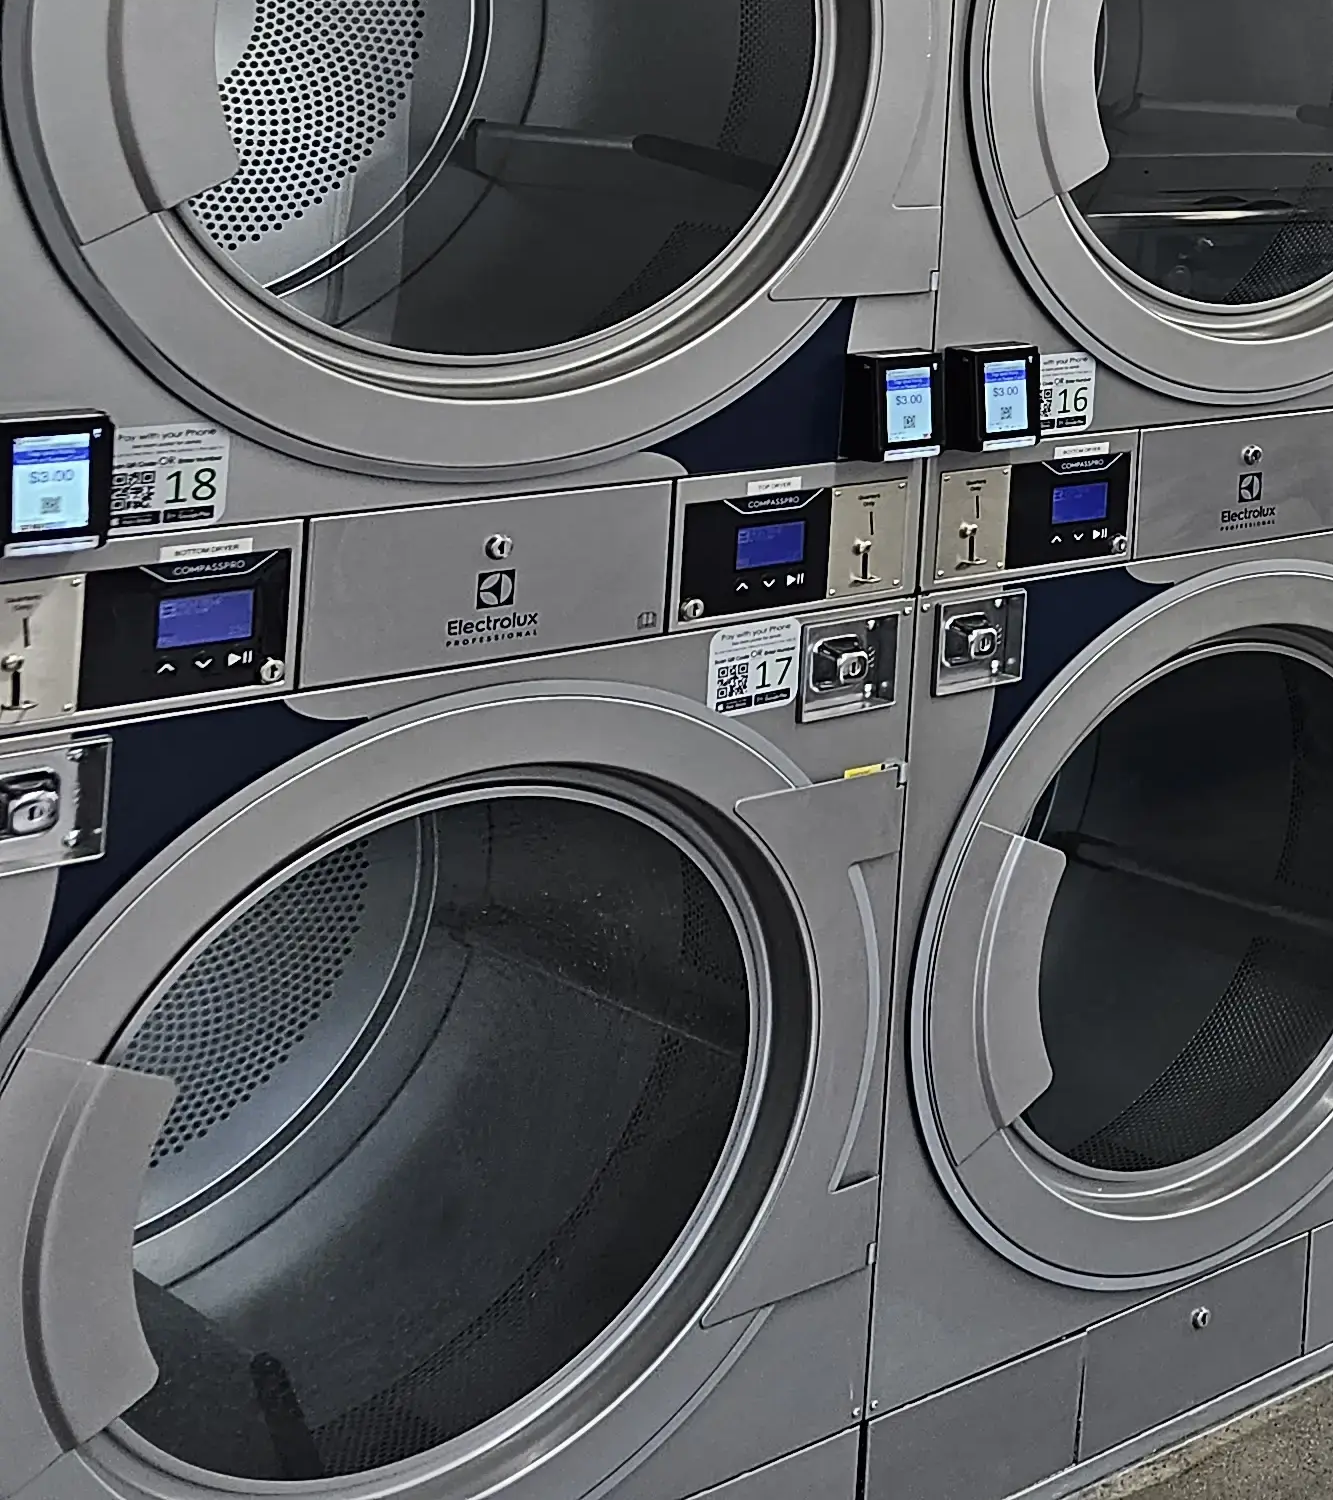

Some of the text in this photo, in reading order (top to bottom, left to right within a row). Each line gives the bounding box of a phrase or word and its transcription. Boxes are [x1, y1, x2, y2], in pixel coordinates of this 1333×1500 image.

[993, 386, 1019, 397] $3.00
[895, 394, 922, 406] $3.00
[1058, 387, 1088, 414] 16
[162, 431, 183, 440] your
[185, 429, 217, 437] Phone
[159, 456, 176, 466] OR
[1061, 459, 1104, 470] COMPASSPRO
[164, 467, 217, 504] 18
[748, 496, 800, 509] COMPASSPRO
[1221, 505, 1276, 523] Electrolux
[174, 548, 210, 557] BOTTOM
[172, 559, 246, 576] COMPASSPRO
[447, 612, 539, 636] Electrolux
[736, 630, 751, 638] with
[752, 627, 768, 636] your
[769, 623, 791, 632] Phone
[445, 629, 538, 647] PROFESSIONAL
[750, 650, 763, 658] OR
[756, 656, 792, 690] 17
